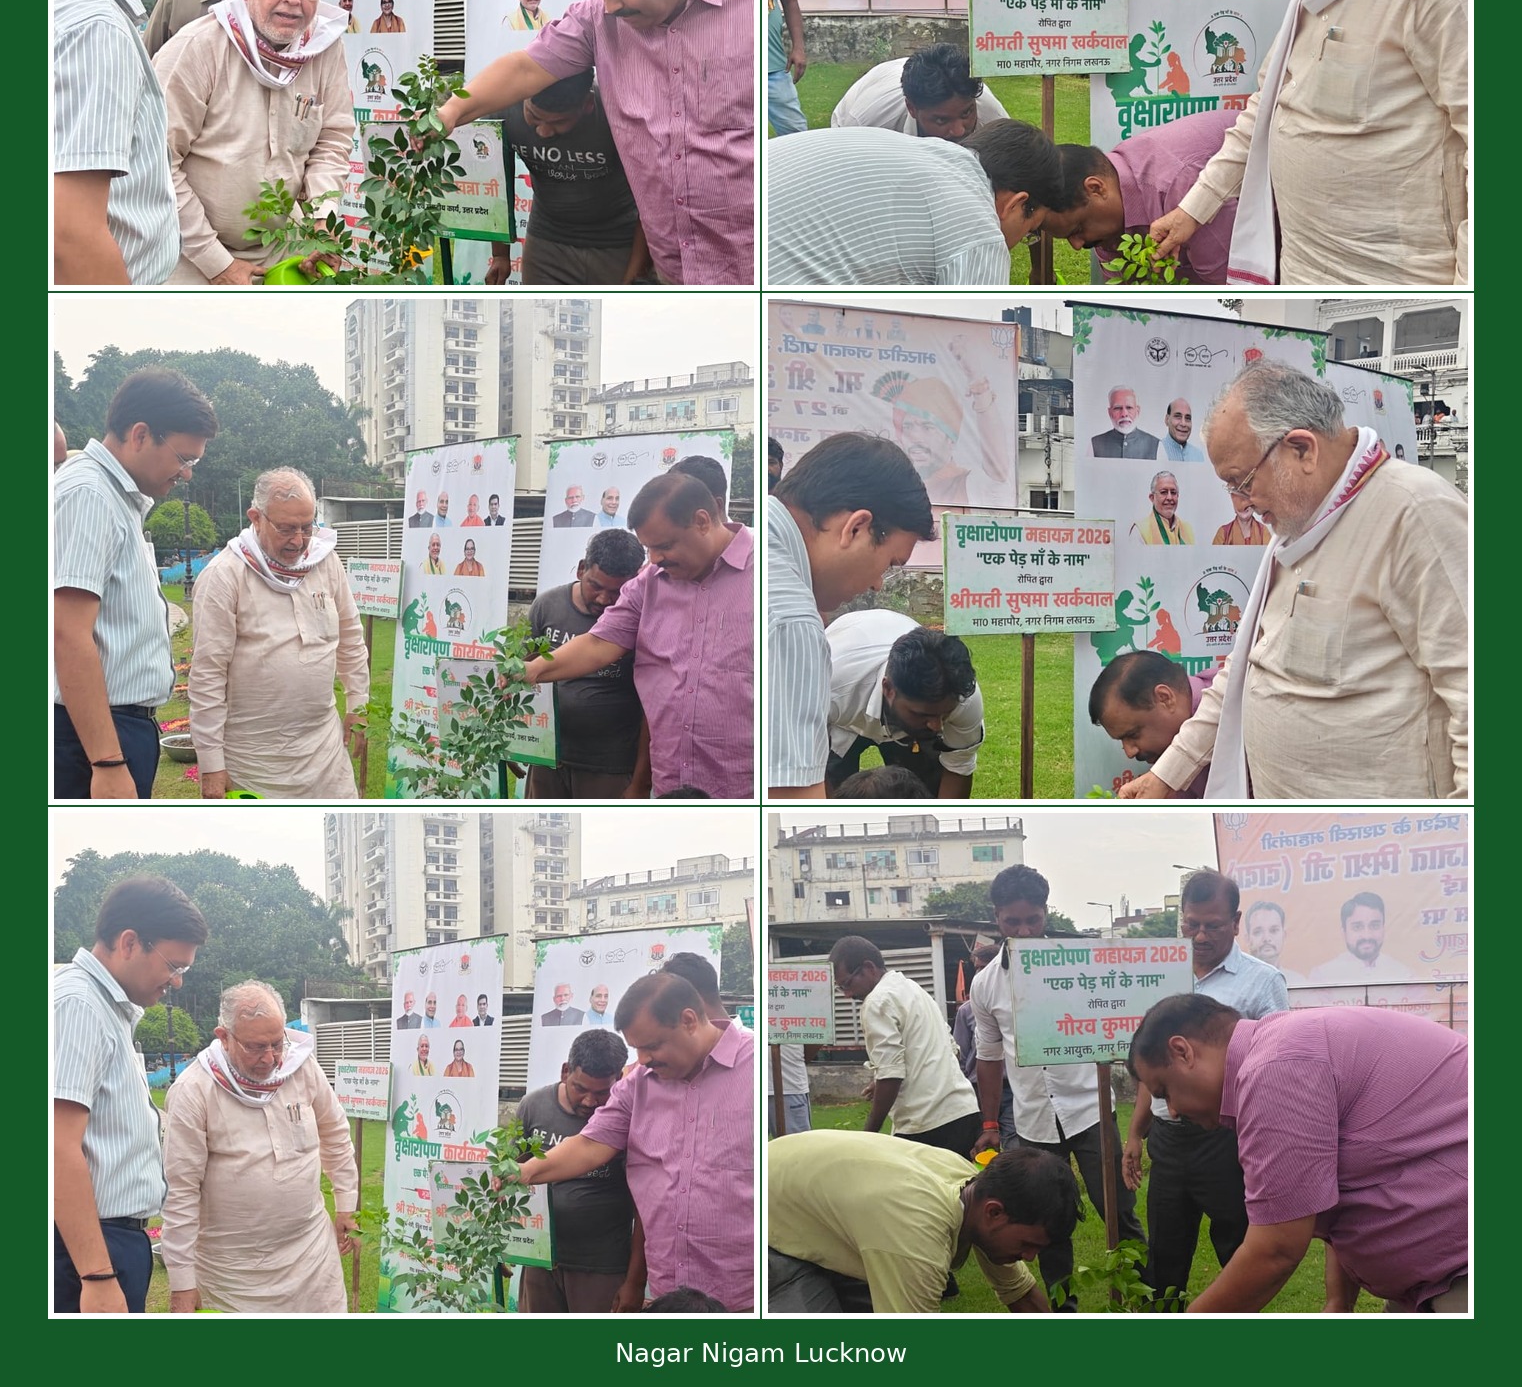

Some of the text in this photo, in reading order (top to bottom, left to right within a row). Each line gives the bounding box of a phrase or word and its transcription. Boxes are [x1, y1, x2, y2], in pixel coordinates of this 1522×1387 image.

[1081, 0, 1106, 10] नाम"
[1038, 18, 1071, 29] रोपित द्वारा
[976, 30, 1128, 55] श्रीमती सुषमा खर्कवाल
[1046, 59, 1060, 67] नगर
[1063, 57, 1082, 67] निगम
[1084, 57, 1110, 67] लखनऊ
[533, 147, 560, 162] NO
[567, 150, 606, 164] LESS
[483, 180, 499, 198] जी
[955, 521, 1111, 548] वृक्षारोपण महायज्ञ 2026
[977, 548, 1090, 568] "एक पेड़ माँ के नाम"
[1018, 574, 1053, 585] रोपित द्वारा
[950, 587, 1114, 613] श्रीमती सुषमा खर्कवाल
[1025, 615, 1095, 626] नगर निगम लखनऊ
[546, 627, 560, 642] BE
[1219, 634, 1232, 643] प्रदेश
[535, 712, 549, 729] जी
[1019, 944, 1187, 975] वृक्षारोपण महायज्ञ 2026
[802, 970, 827, 982] 2026
[1043, 969, 1165, 993] "एक पेड़ माँ के नाम"
[780, 986, 790, 997] के
[1088, 998, 1126, 1010] रोपित द्वारा
[779, 1017, 827, 1031] कुमार राव
[1056, 1013, 1097, 1036] गौरव
[1043, 1047, 1060, 1056] नगर
[1098, 1043, 1115, 1054] नगर
[530, 1214, 544, 1230] जी
